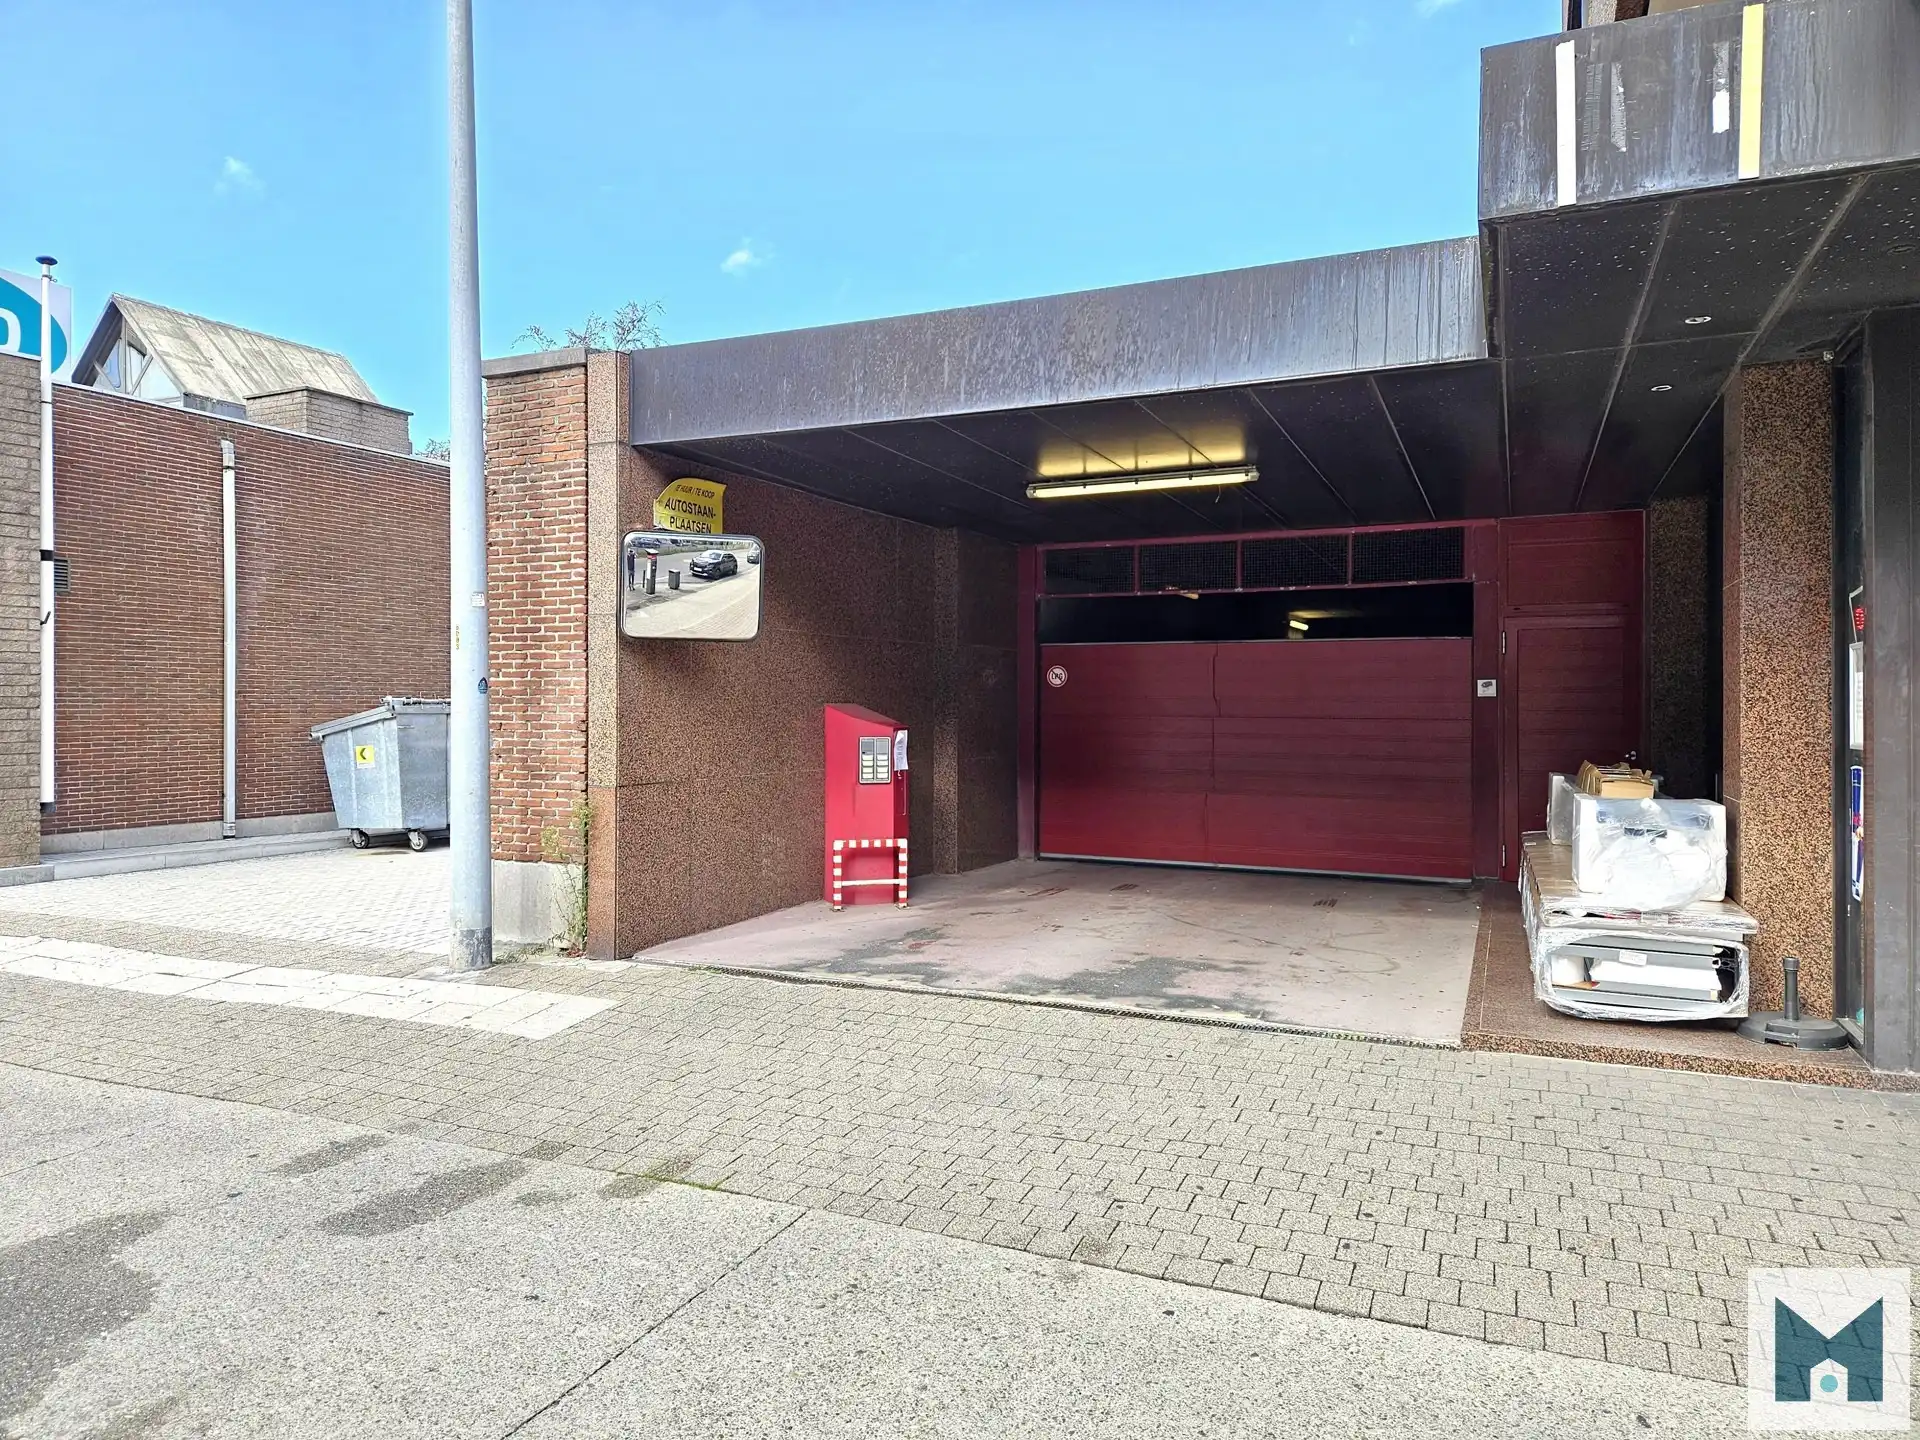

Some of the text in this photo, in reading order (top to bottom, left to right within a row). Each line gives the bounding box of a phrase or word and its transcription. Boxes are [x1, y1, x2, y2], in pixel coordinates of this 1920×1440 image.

[701, 489, 715, 499] KOOP
[664, 497, 716, 519] AUTOSTAAN-
[670, 516, 712, 533] PLAATSEN
